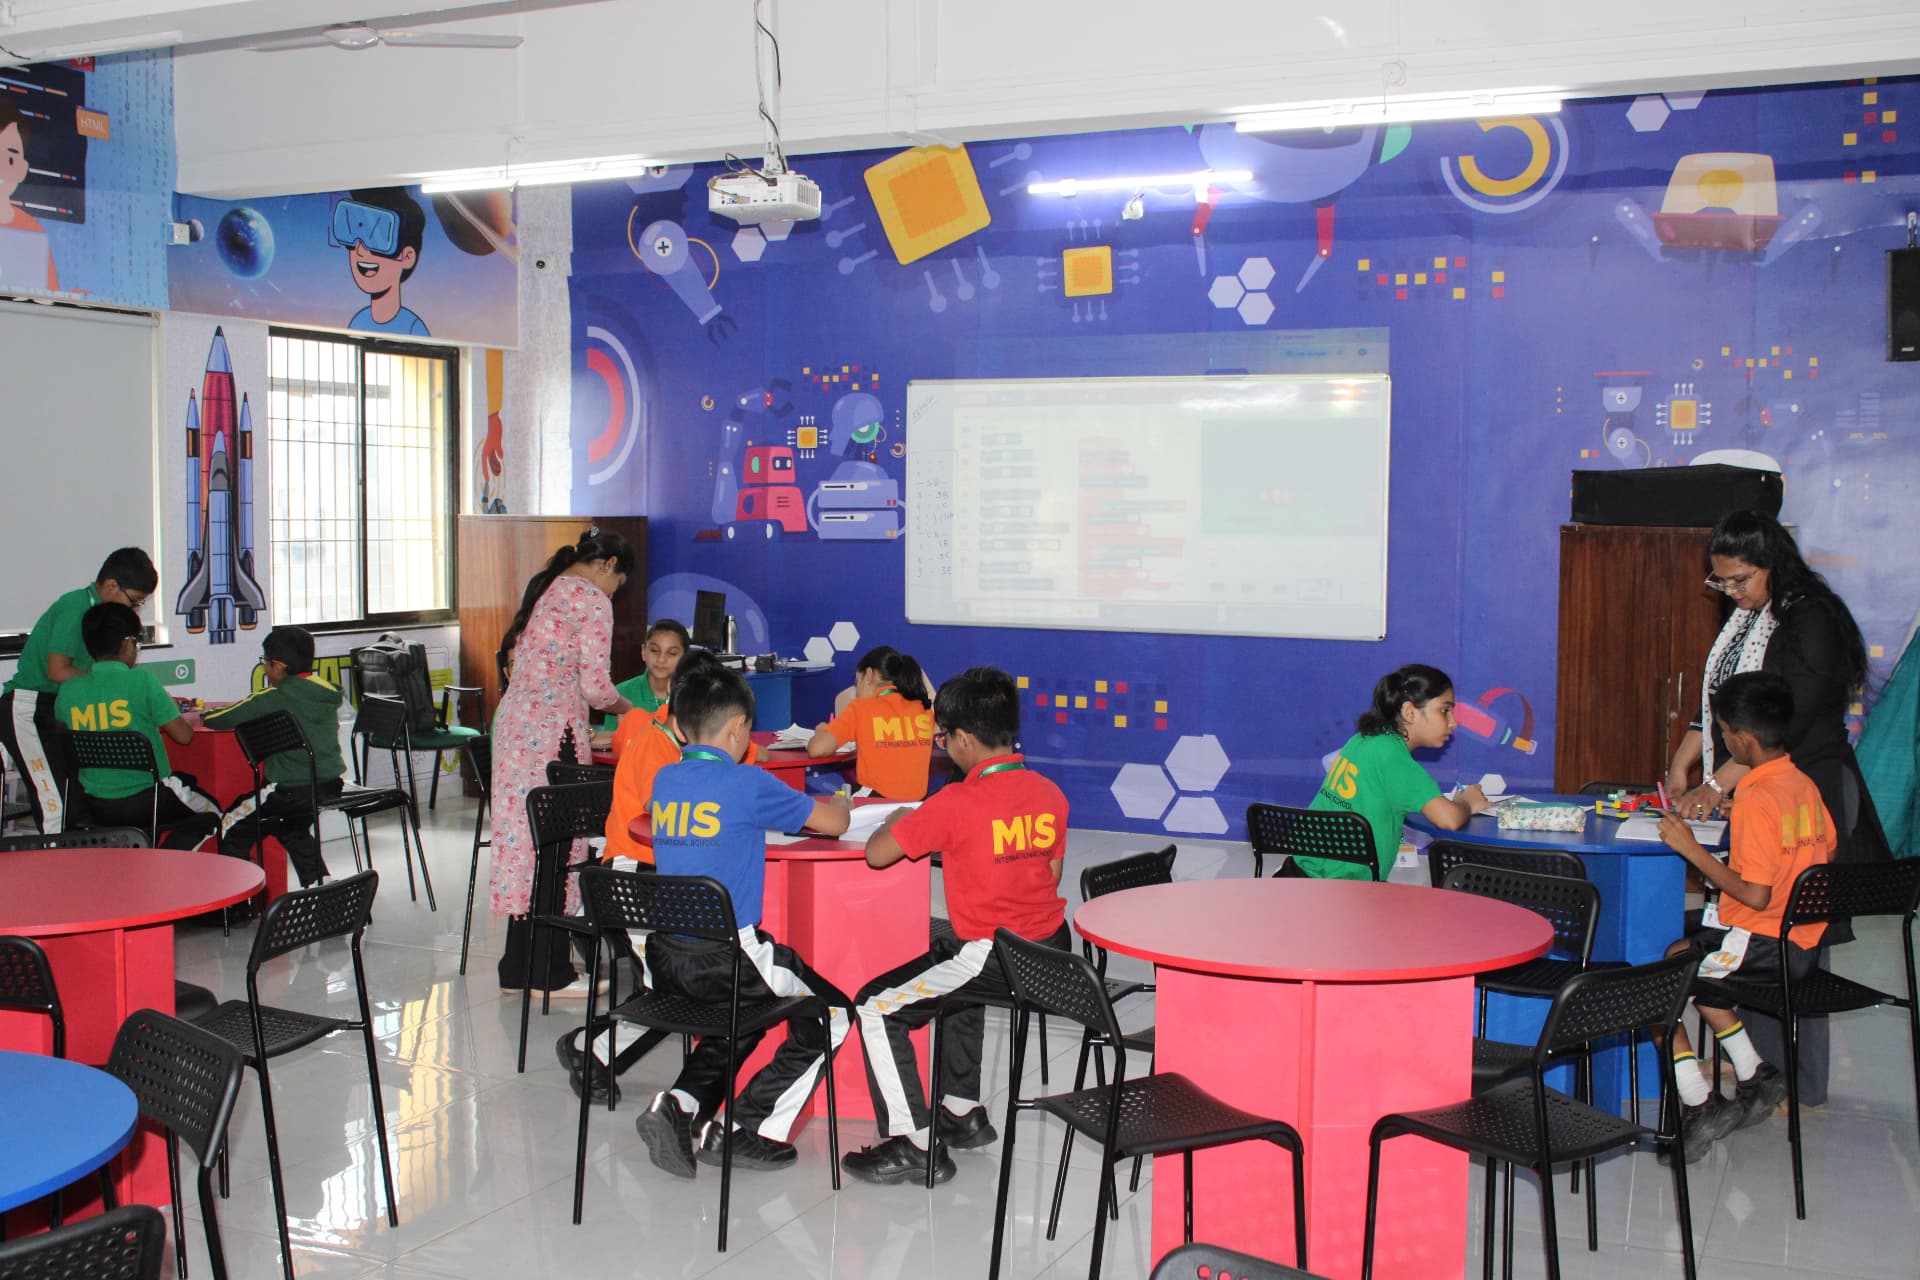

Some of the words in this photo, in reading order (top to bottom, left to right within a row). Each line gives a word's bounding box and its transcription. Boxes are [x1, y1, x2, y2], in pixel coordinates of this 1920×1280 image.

[70, 699, 131, 731] MIS
[872, 713, 932, 742] MIS
[652, 800, 721, 838] MIS
[991, 812, 1056, 855] MIS
